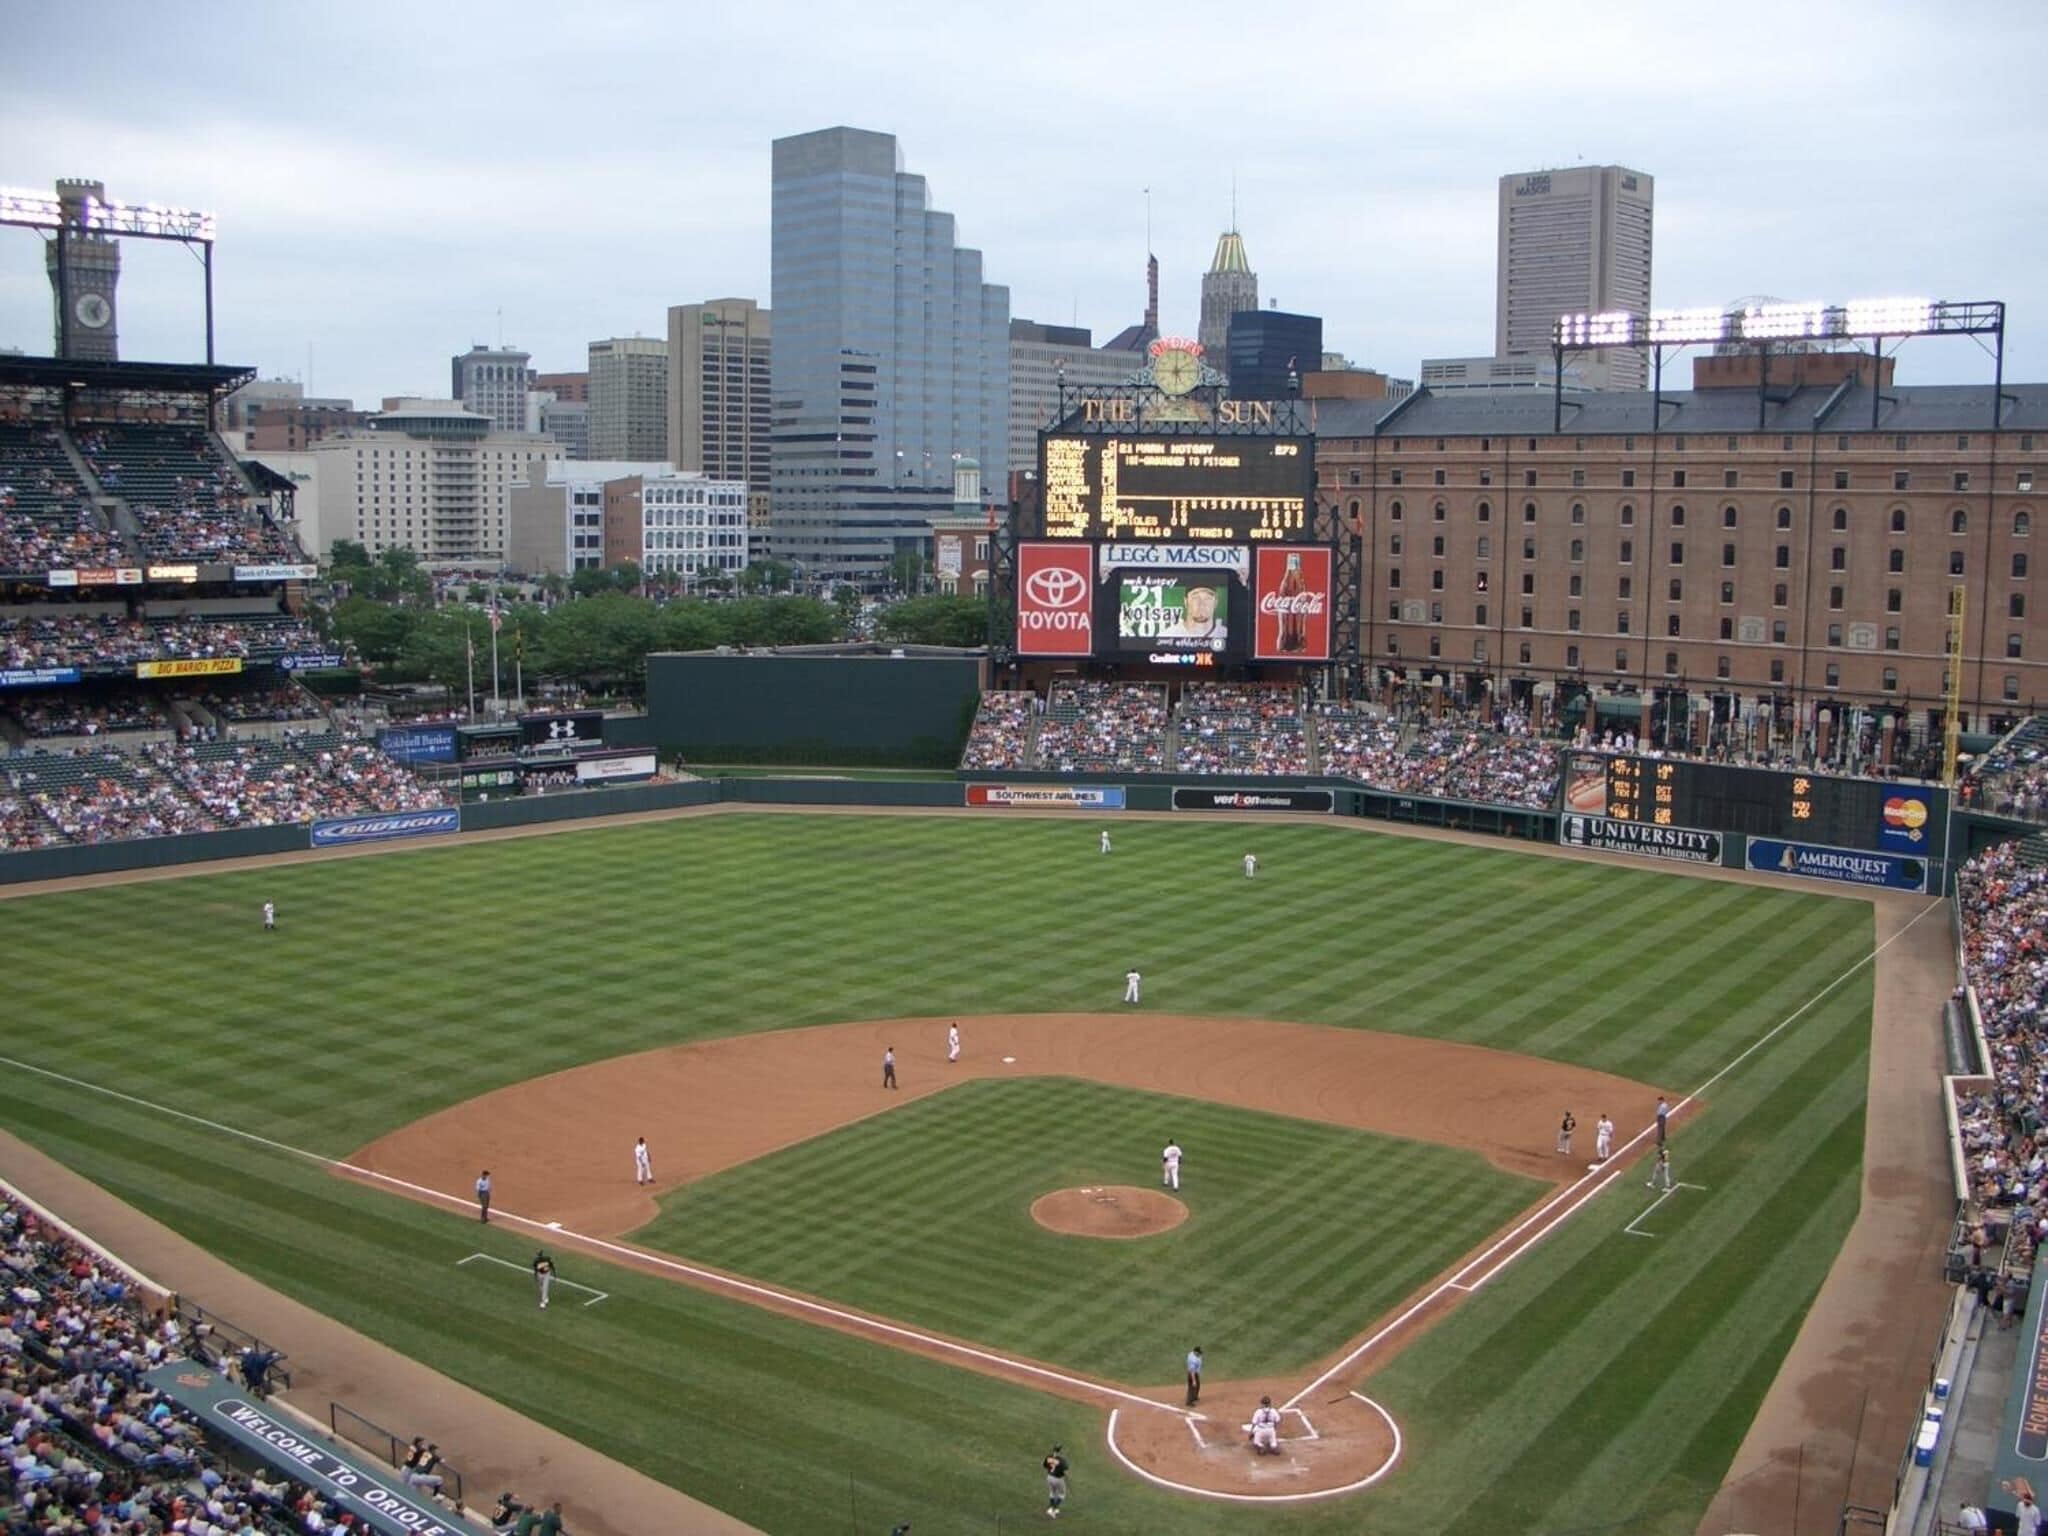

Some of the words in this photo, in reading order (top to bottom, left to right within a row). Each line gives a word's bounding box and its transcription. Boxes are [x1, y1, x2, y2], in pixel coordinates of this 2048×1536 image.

[1081, 400, 1135, 422] THE
[1219, 401, 1273, 424] SUN
[1163, 527, 1171, 537] 0
[1224, 528, 1233, 538] 0
[1275, 529, 1283, 539] 0
[1107, 548, 1160, 562] LEGG
[1166, 549, 1241, 563] MASON
[1130, 586, 1163, 608] 21
[1020, 611, 1091, 630] TOYOTA
[1122, 604, 1182, 624] kotsay
[212, 660, 235, 671] PIZZA
[996, 791, 1053, 800] SOUTHWEST
[1214, 793, 1260, 807] verizon
[390, 815, 456, 829] LIGHT
[1591, 820, 1711, 849] UNIVERSITY
[1605, 839, 1658, 855] MARYLAND
[1799, 850, 1890, 874] AMERIQUEST
[2024, 1394, 2048, 1434] HOME
[231, 1406, 324, 1464] WELCOME
[327, 1465, 358, 1485] TO
